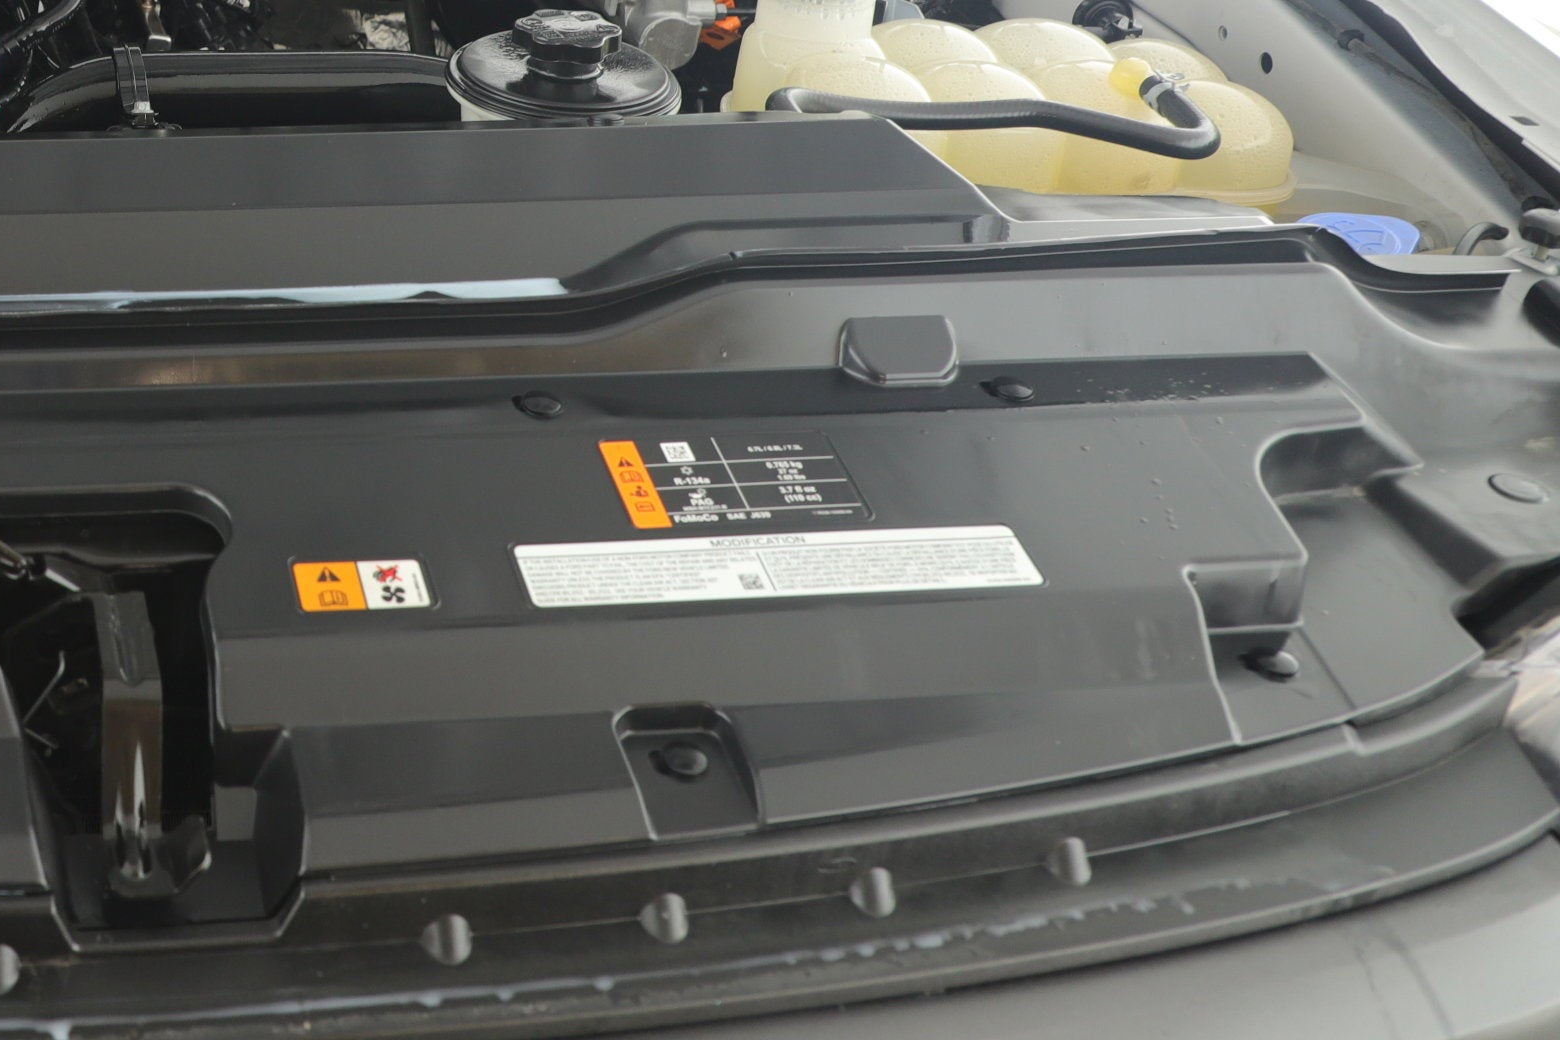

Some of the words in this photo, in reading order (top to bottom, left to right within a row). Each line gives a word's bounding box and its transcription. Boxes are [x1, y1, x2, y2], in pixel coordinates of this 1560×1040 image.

[673, 476, 711, 486] R-134a
[690, 497, 714, 506] PAG
[673, 513, 719, 523] FoMoCo
[726, 512, 747, 520] SAE
[709, 535, 806, 548] MODIFICATION
